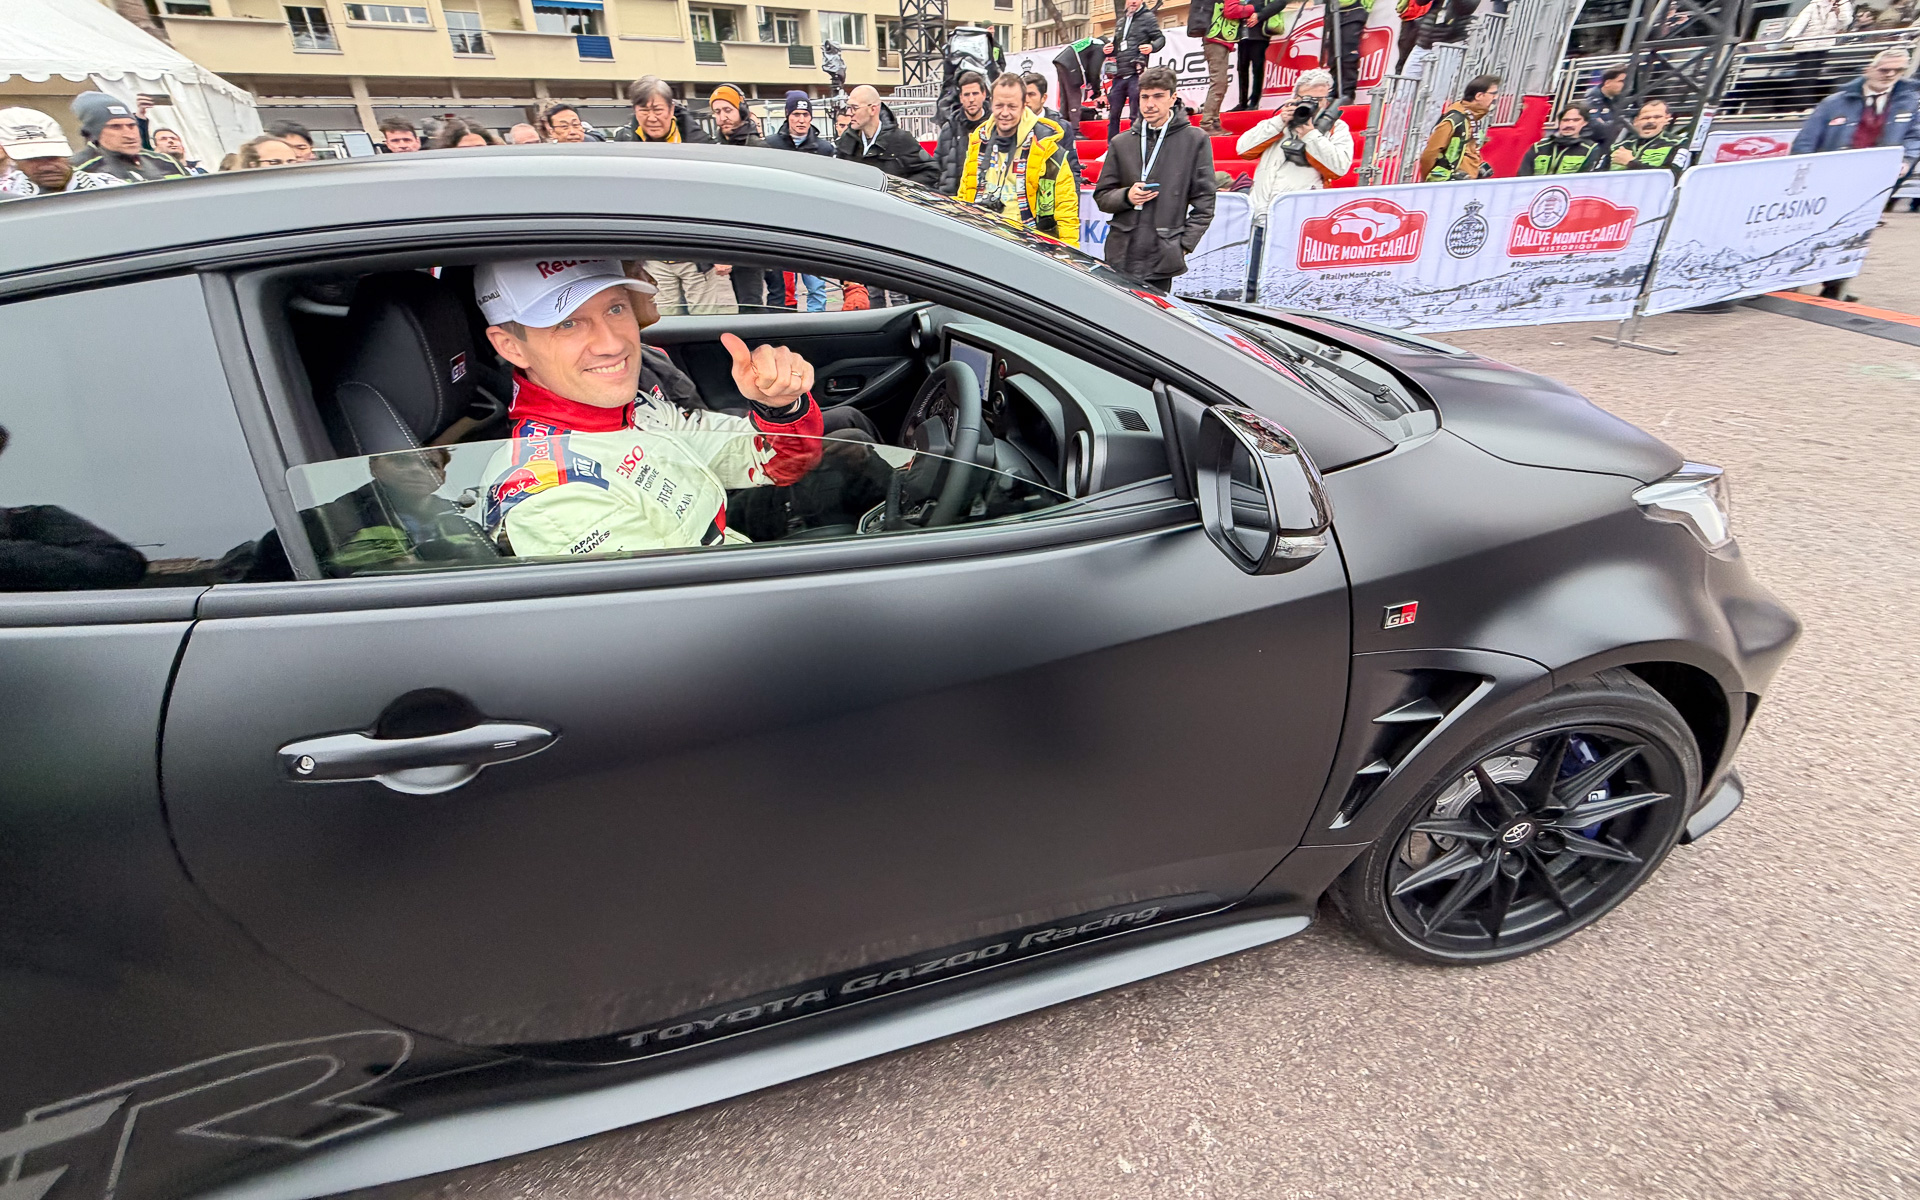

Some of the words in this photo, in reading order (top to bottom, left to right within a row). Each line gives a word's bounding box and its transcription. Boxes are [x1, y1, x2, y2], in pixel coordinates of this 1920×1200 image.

[1263, 61, 1298, 89] RALLYE
[1745, 205, 1766, 225] LE
[1767, 197, 1827, 222] CASINO
[1302, 236, 1340, 263] RALLYE
[1340, 229, 1420, 260] MONTE-CARLO
[1512, 224, 1552, 247] RALLYE
[1551, 218, 1632, 245] MONTE-CARLO
[1538, 243, 1598, 252] HISTORIQUE
[1320, 270, 1392, 280] #RallyeMonteCarlo
[1386, 612, 1415, 626] GR
[617, 988, 830, 1048] TOYOTA
[840, 941, 1012, 995] GAZOO
[1018, 904, 1168, 950] Racing
